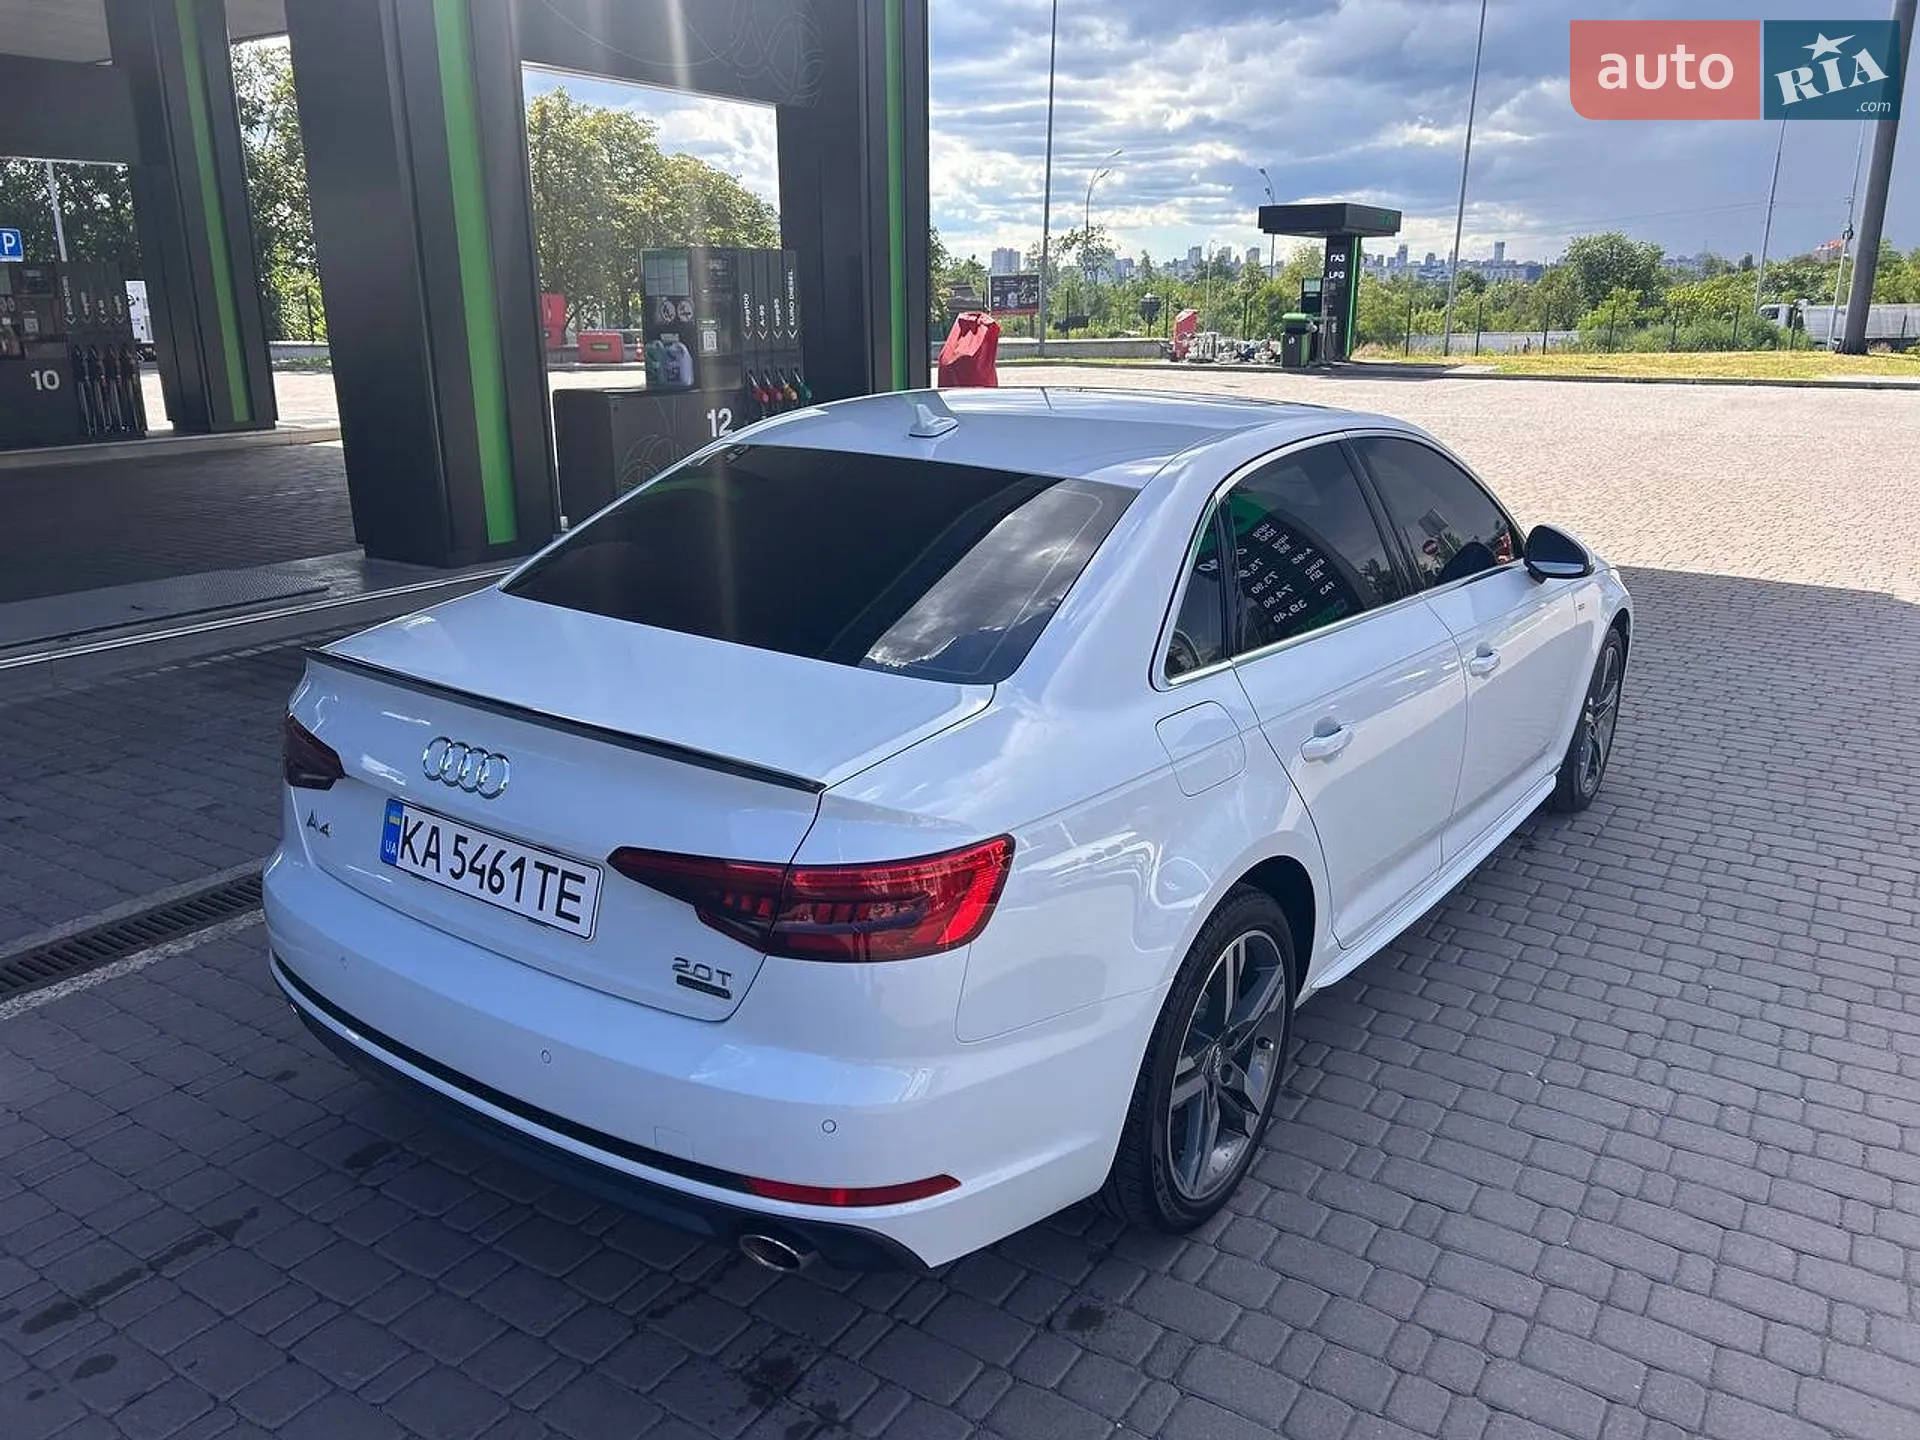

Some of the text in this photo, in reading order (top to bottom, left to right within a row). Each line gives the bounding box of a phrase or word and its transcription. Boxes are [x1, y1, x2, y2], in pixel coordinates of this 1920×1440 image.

[2, 233, 15, 254] P
[1330, 254, 1345, 262] ГАЗ
[1329, 271, 1345, 279] LPG
[30, 369, 60, 391] 10
[707, 408, 732, 437] 12
[306, 811, 330, 838] A4
[385, 840, 397, 855] UA
